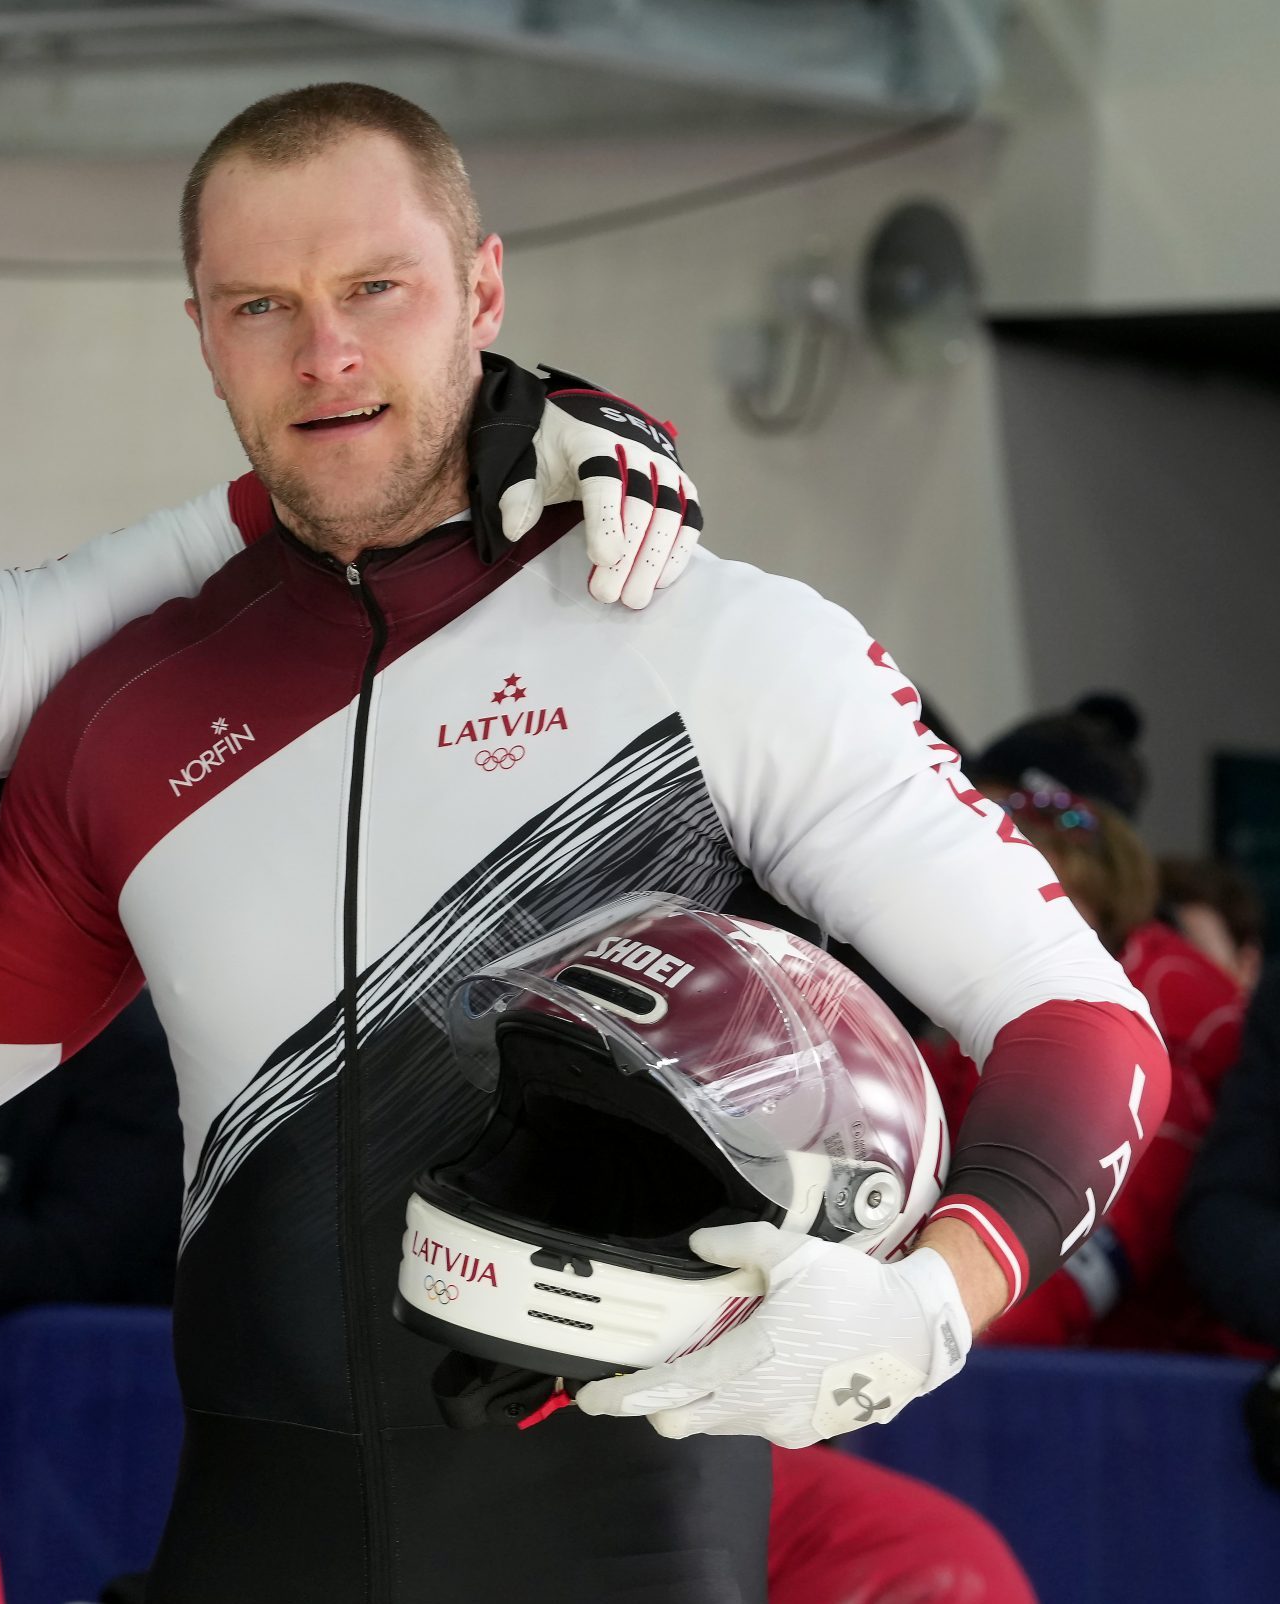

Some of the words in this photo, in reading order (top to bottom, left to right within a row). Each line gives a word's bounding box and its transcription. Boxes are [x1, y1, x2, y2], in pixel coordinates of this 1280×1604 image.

[599, 406, 678, 463] SEIZ
[437, 706, 568, 748] LATVIJA
[168, 723, 255, 797] NORFIN
[585, 936, 695, 988] SHOEI
[412, 1230, 498, 1288] LATVIJA
